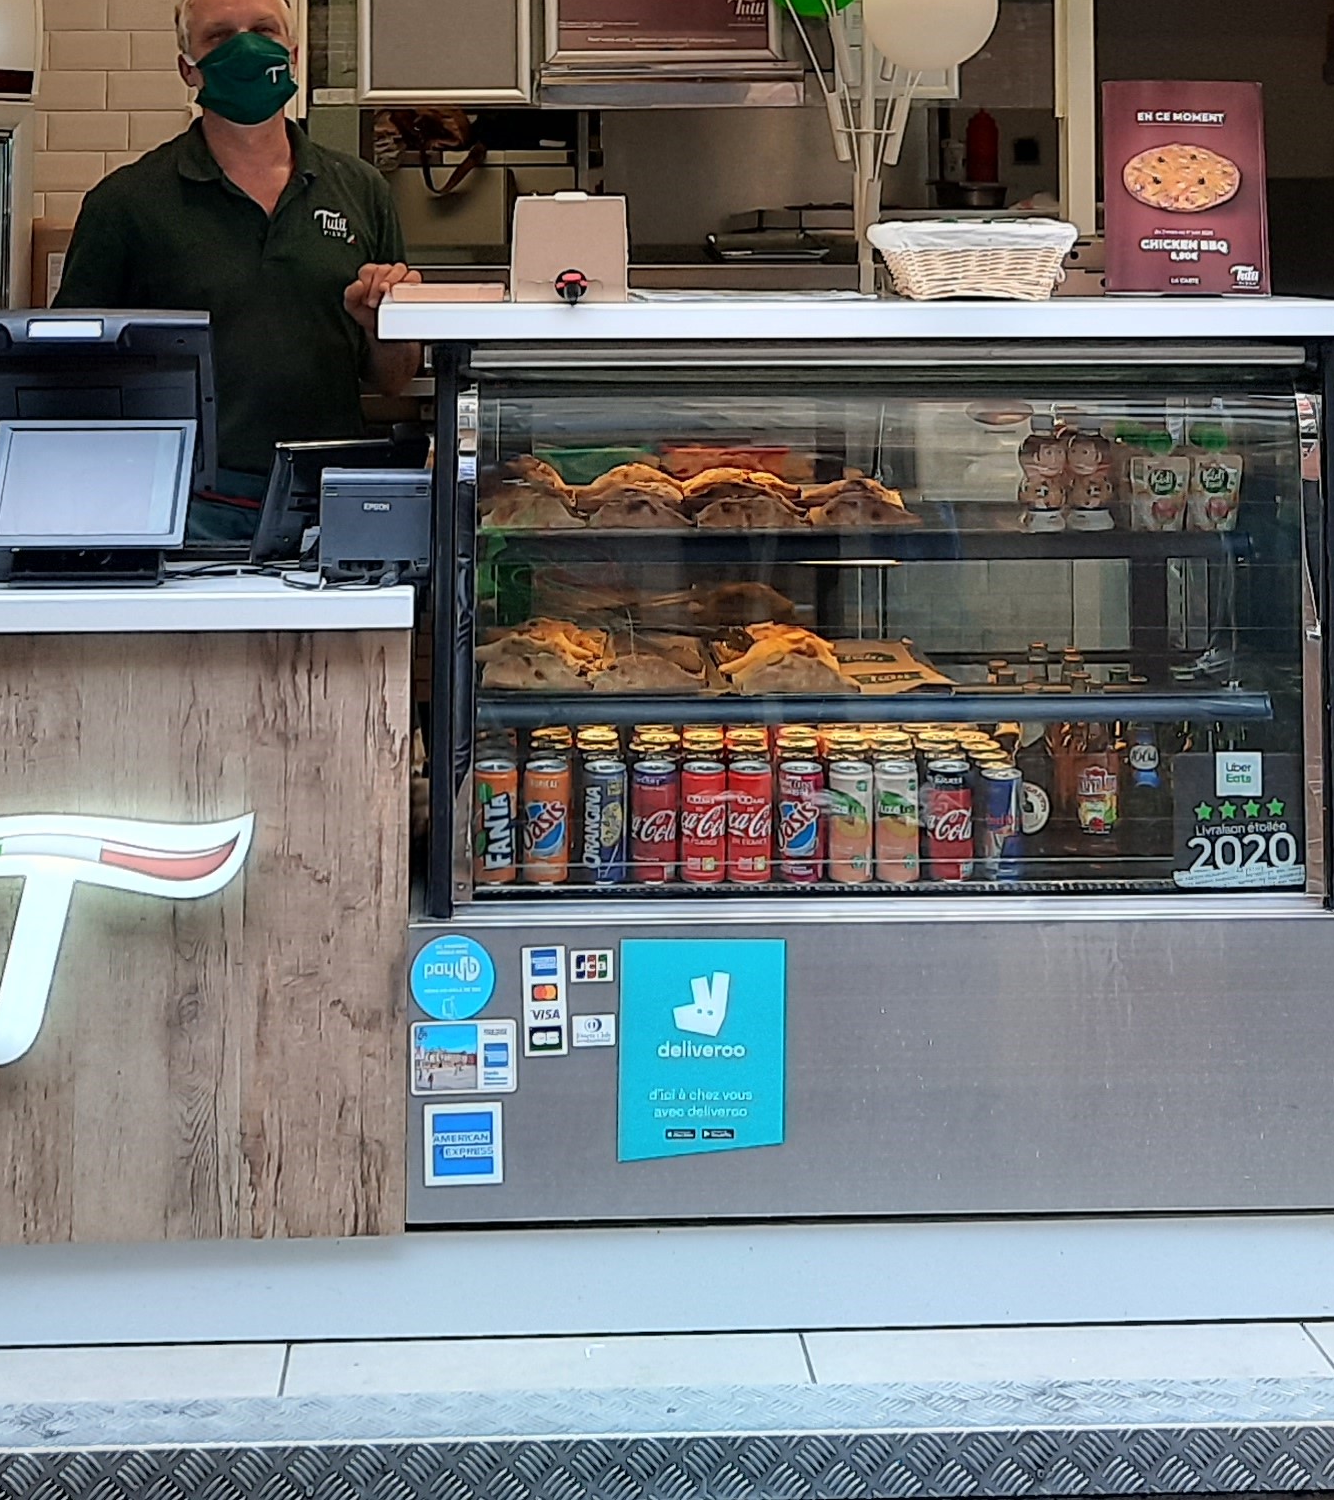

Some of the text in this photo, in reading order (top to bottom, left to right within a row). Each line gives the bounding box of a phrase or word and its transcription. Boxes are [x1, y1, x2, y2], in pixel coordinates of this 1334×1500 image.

[266, 64, 286, 83] T
[1137, 112, 1224, 122] EN CE MOMENT
[1141, 239, 1228, 254] CHICKEN BBQ
[1226, 762, 1251, 772] Uber
[1226, 774, 1251, 783] Eats
[485, 794, 511, 868] FANTA
[583, 786, 601, 868] ORANGINA
[1196, 824, 1245, 836] Livraison
[1188, 832, 1296, 870] 2020
[530, 1009, 560, 1020] VISA
[658, 1040, 745, 1057] deliveroo
[689, 1088, 719, 1100] chez
[723, 1091, 752, 1100] vous
[654, 1105, 747, 1118] avec deliveroo
[434, 1133, 488, 1143] AMERICAN
[446, 1147, 493, 1156] EXPRESS
